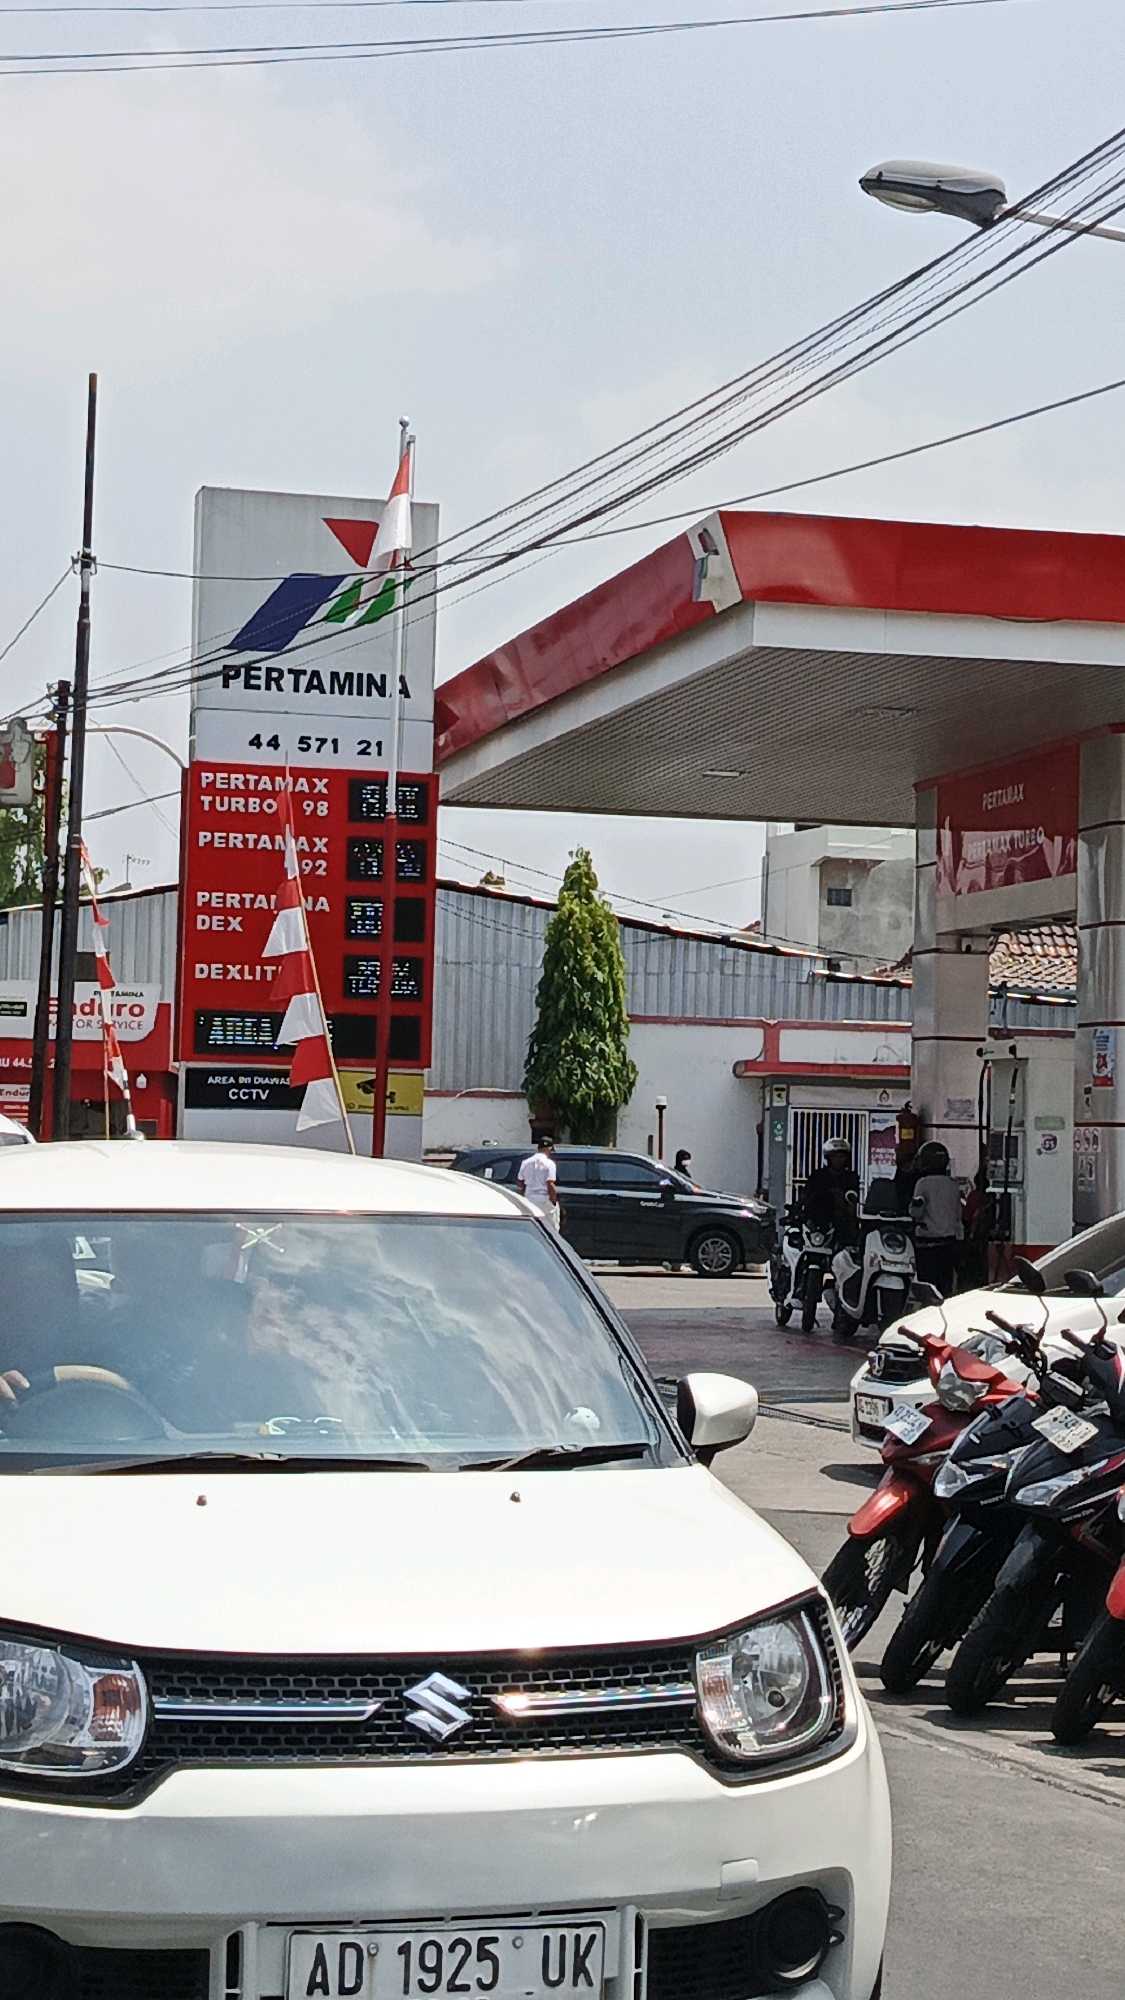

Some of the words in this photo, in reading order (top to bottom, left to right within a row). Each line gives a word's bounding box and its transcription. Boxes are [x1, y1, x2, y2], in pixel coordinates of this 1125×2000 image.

[222, 664, 411, 699] PERTAMINA
[249, 734, 280, 750] 44
[298, 736, 339, 754] 571
[357, 740, 383, 757] 21
[201, 773, 329, 794] PERTAMAX
[201, 796, 278, 814] TURBO
[303, 801, 329, 817] 98
[983, 783, 1025, 811] PERTAMAX
[302, 860, 328, 876] 92
[197, 892, 330, 912] PERTANA
[197, 916, 243, 932] DEX
[195, 964, 281, 981] DEXLIT
[207, 1075, 236, 1085] AREA
[254, 1076, 291, 1086] DIAWAS
[229, 1088, 270, 1101] CCTV
[306, 1941, 364, 1997] AD
[397, 1936, 500, 1996] 1925
[542, 1933, 598, 1988] UK
